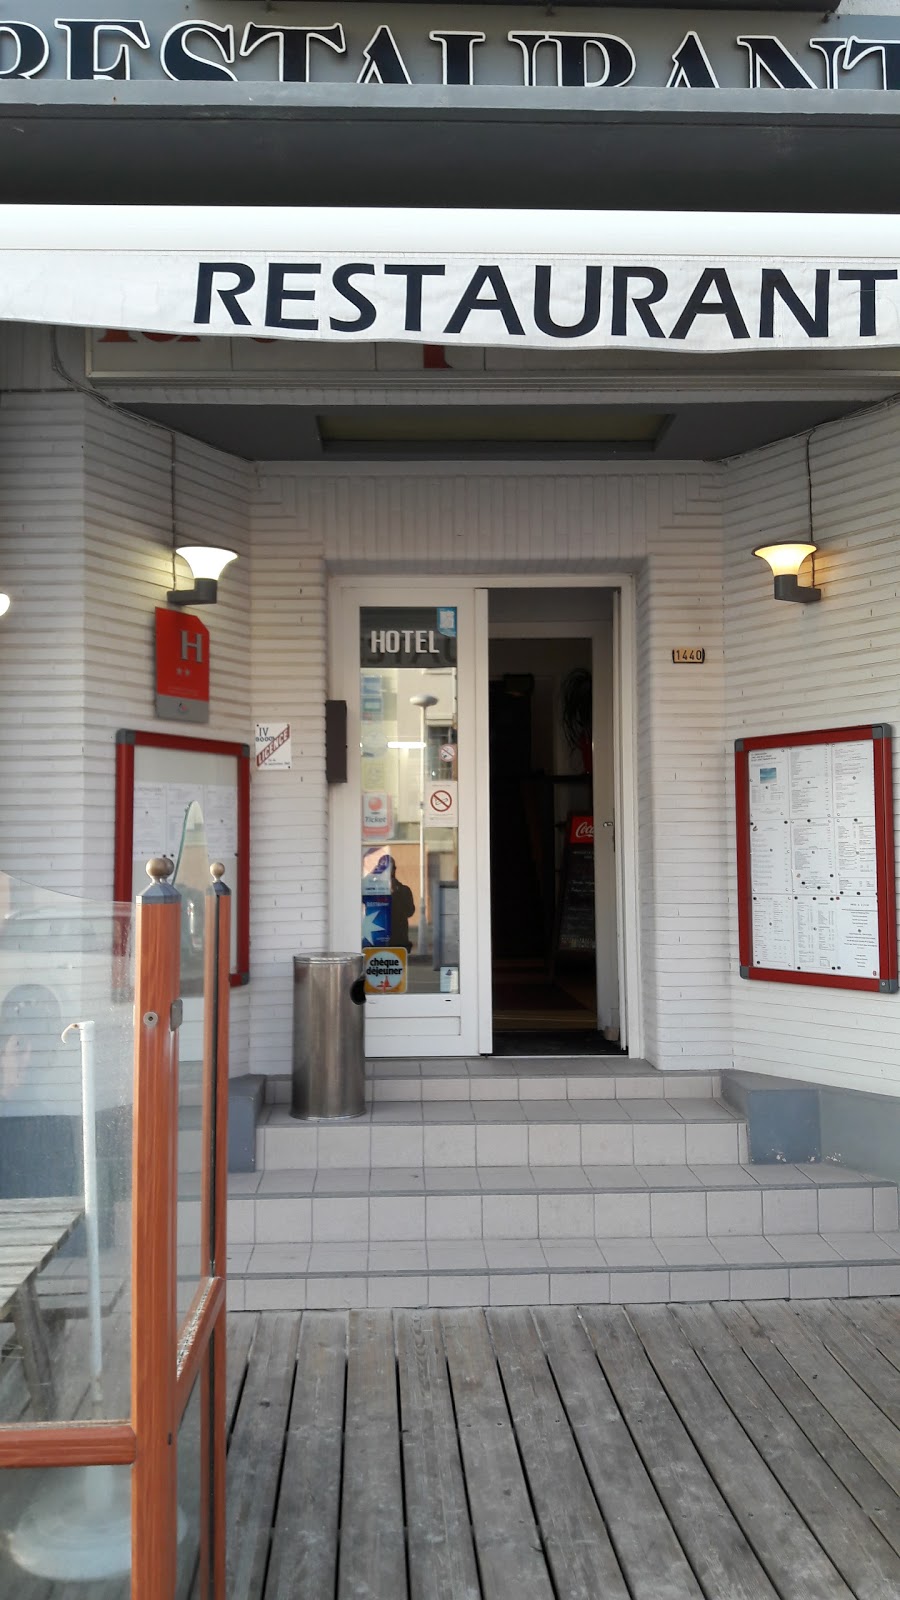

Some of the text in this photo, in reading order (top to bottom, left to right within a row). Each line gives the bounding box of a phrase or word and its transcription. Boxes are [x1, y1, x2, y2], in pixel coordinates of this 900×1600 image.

[194, 262, 898, 340] RESTAURANT
[181, 631, 203, 663] H
[371, 630, 440, 653] HOTEL
[676, 649, 702, 661] 1440
[259, 727, 269, 737] IV
[256, 724, 290, 767] LICENCE
[366, 966, 403, 977] déjeuner
